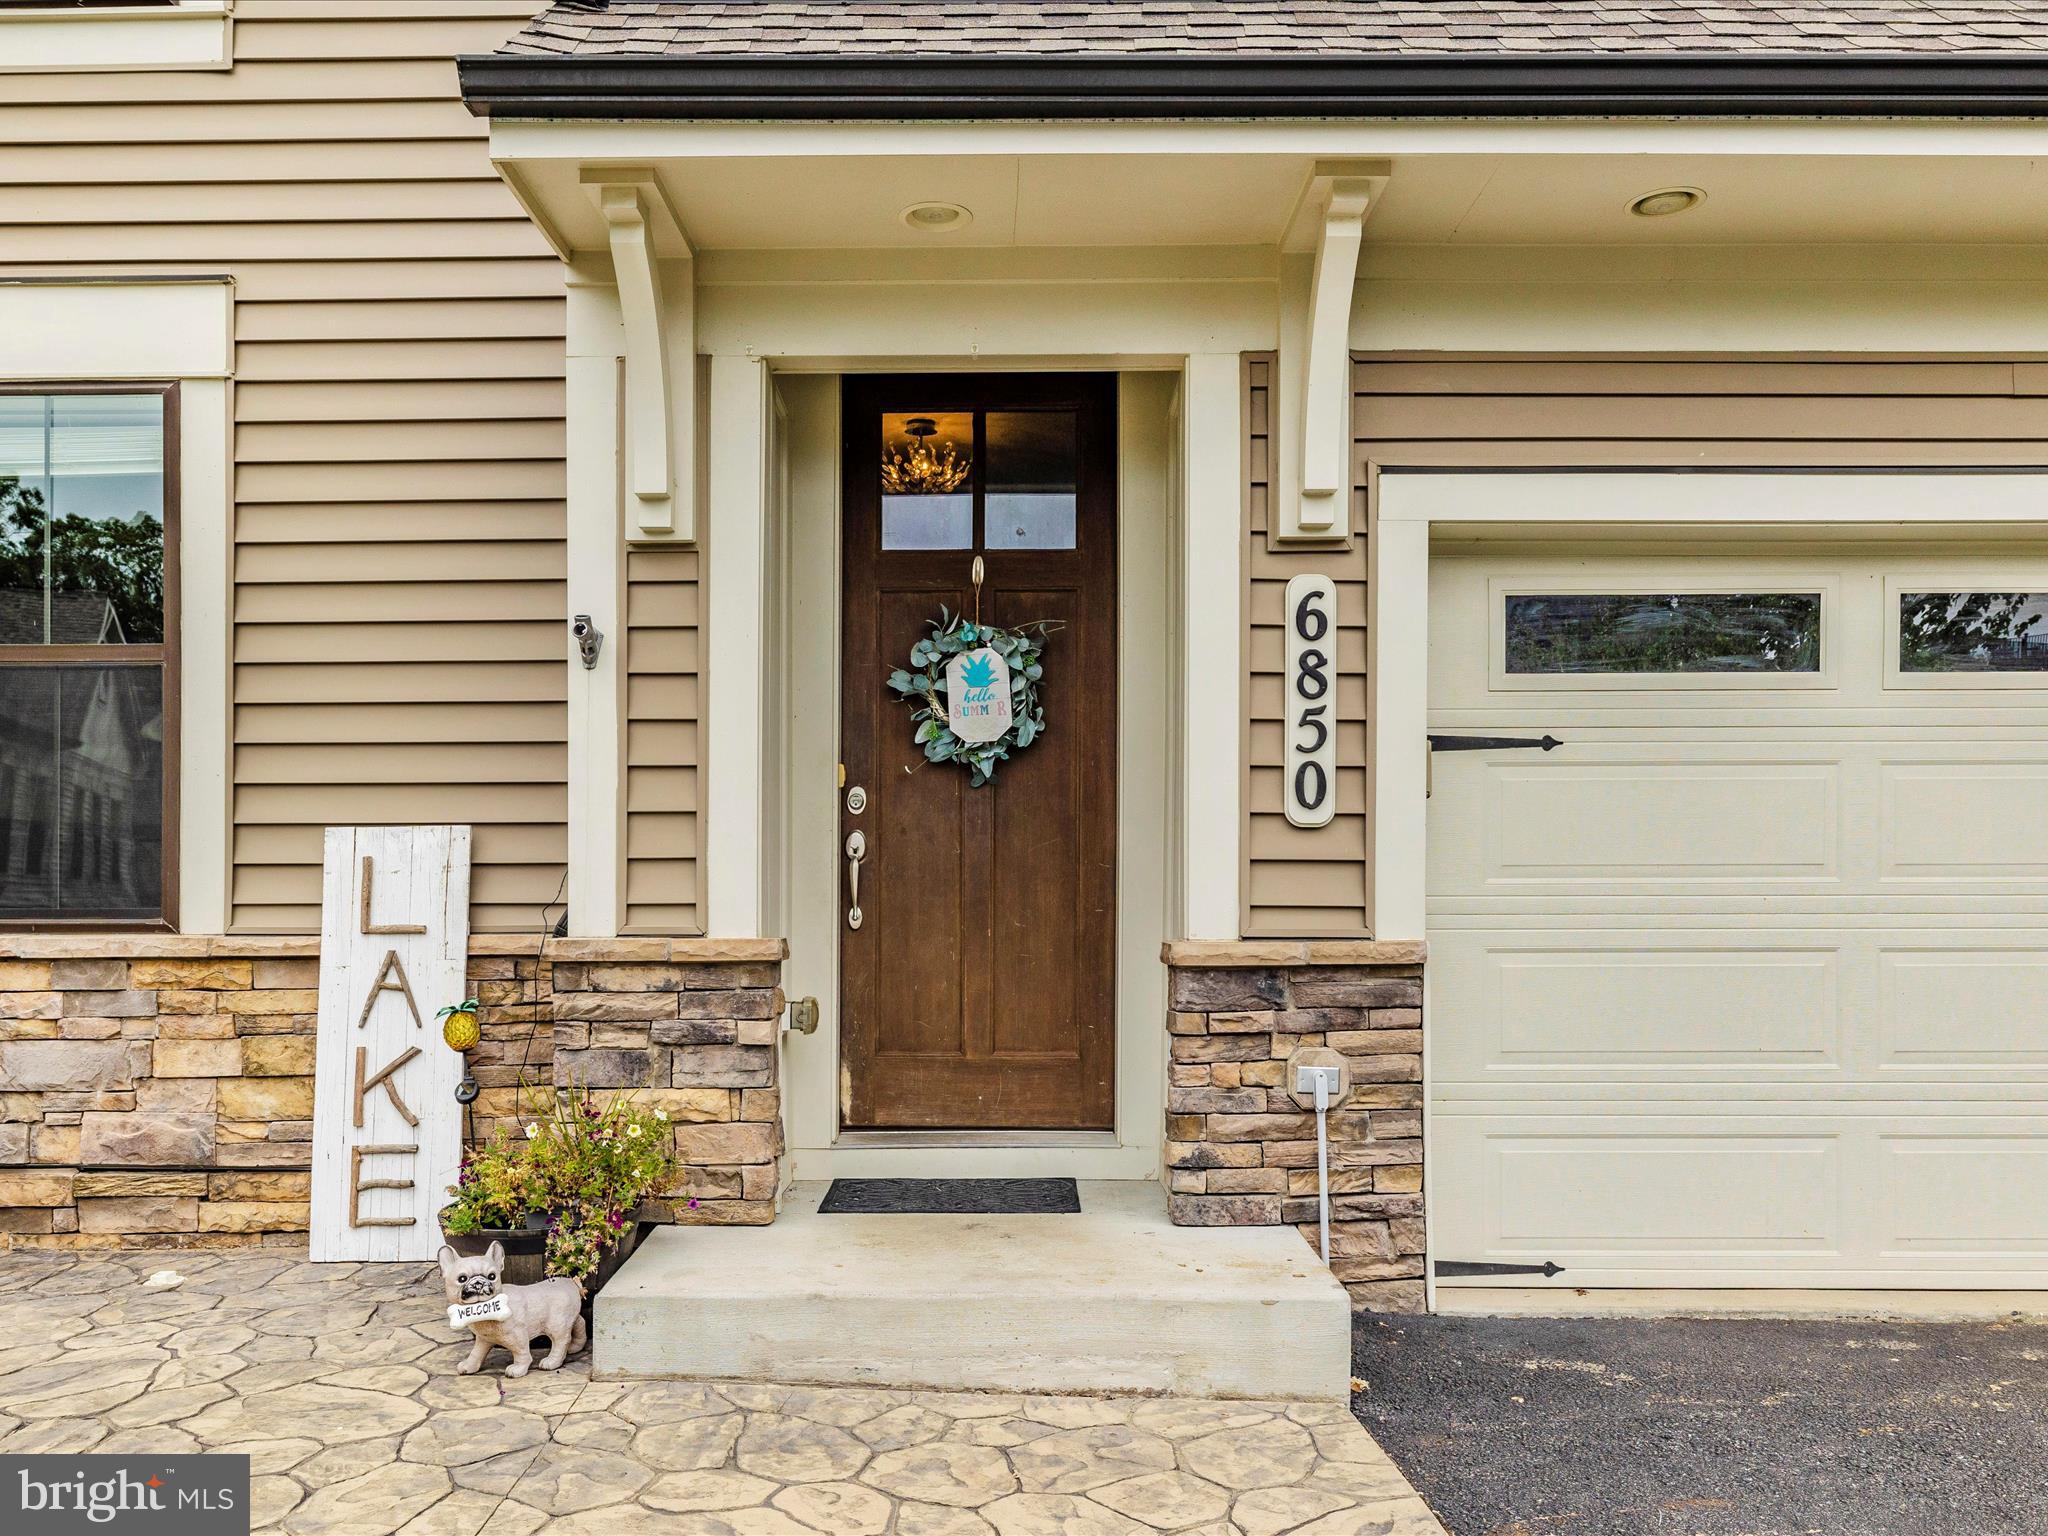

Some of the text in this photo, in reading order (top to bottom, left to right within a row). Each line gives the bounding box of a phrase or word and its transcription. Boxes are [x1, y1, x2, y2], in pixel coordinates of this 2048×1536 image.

[964, 687, 997, 703] hello
[1295, 590, 1328, 810] 6850
[953, 700, 1007, 720] SUMMR
[349, 855, 427, 1228] LAKE
[457, 1300, 501, 1319] WELCOME
